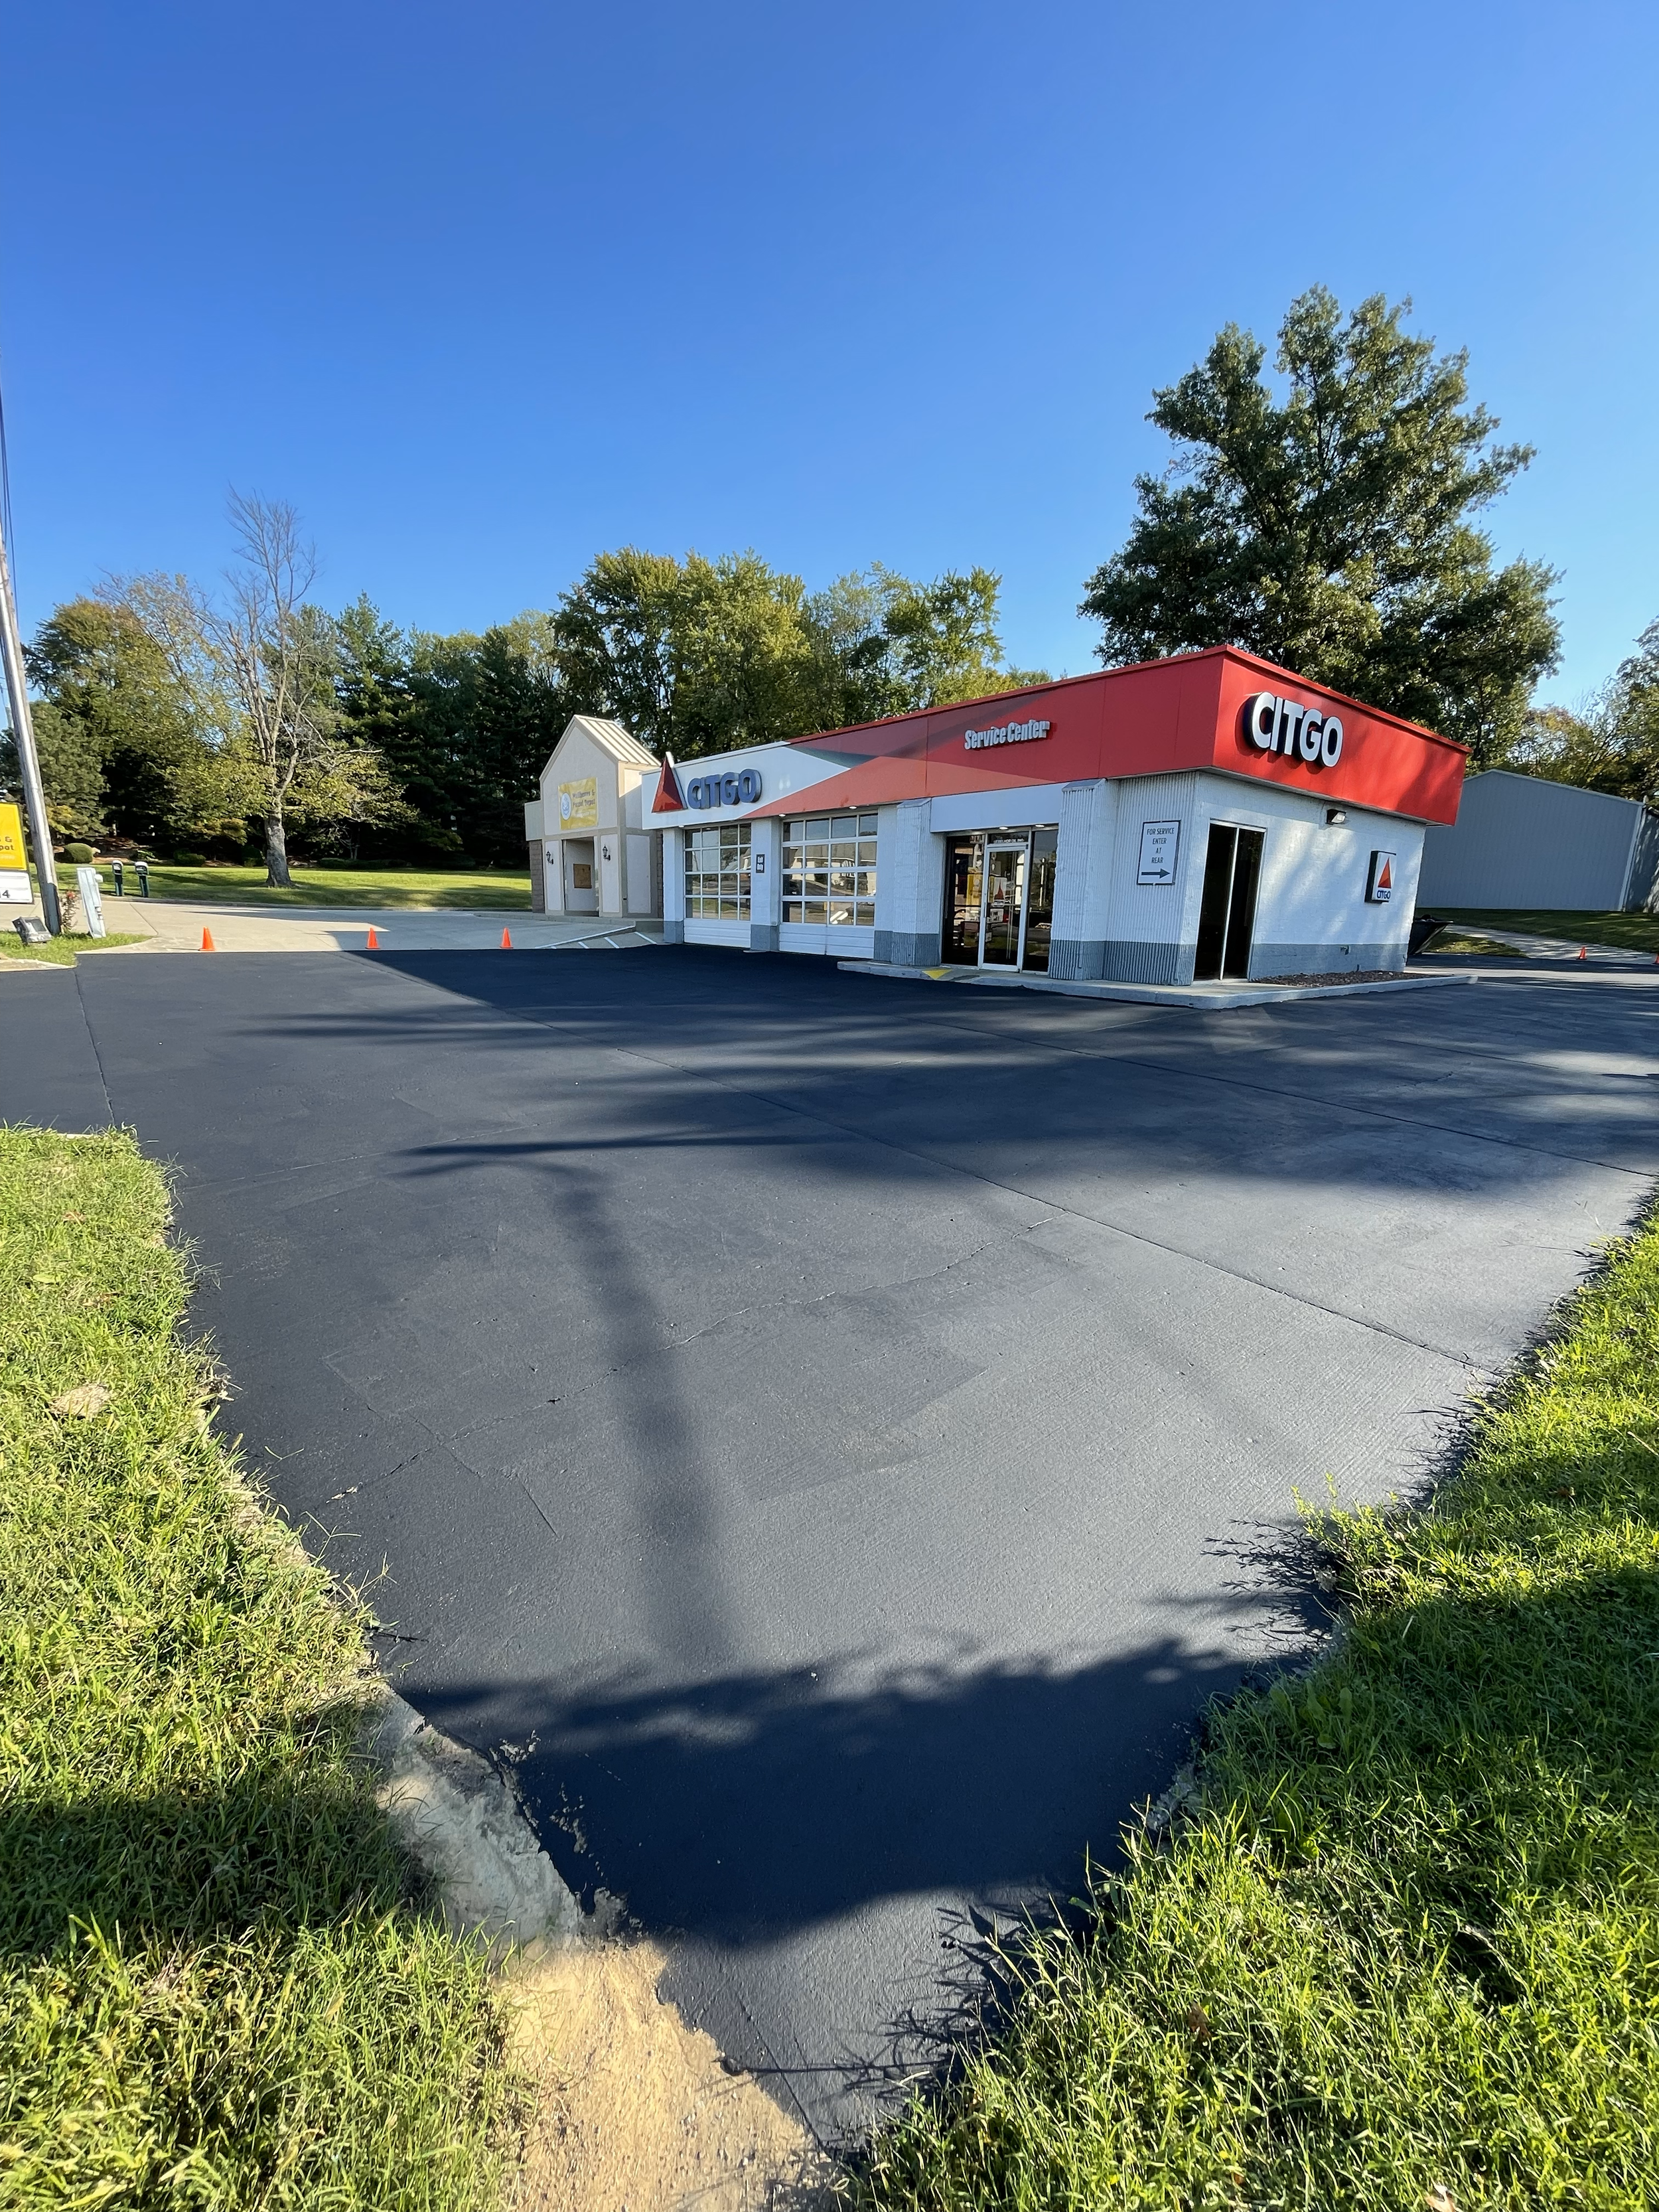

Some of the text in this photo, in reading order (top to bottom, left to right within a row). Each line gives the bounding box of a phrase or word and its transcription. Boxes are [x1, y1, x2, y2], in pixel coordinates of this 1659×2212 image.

[964, 719, 1050, 750] Service Center
[1251, 691, 1344, 768] CITGO
[687, 769, 762, 809] CITGO
[1376, 890, 1391, 899] CITGO
